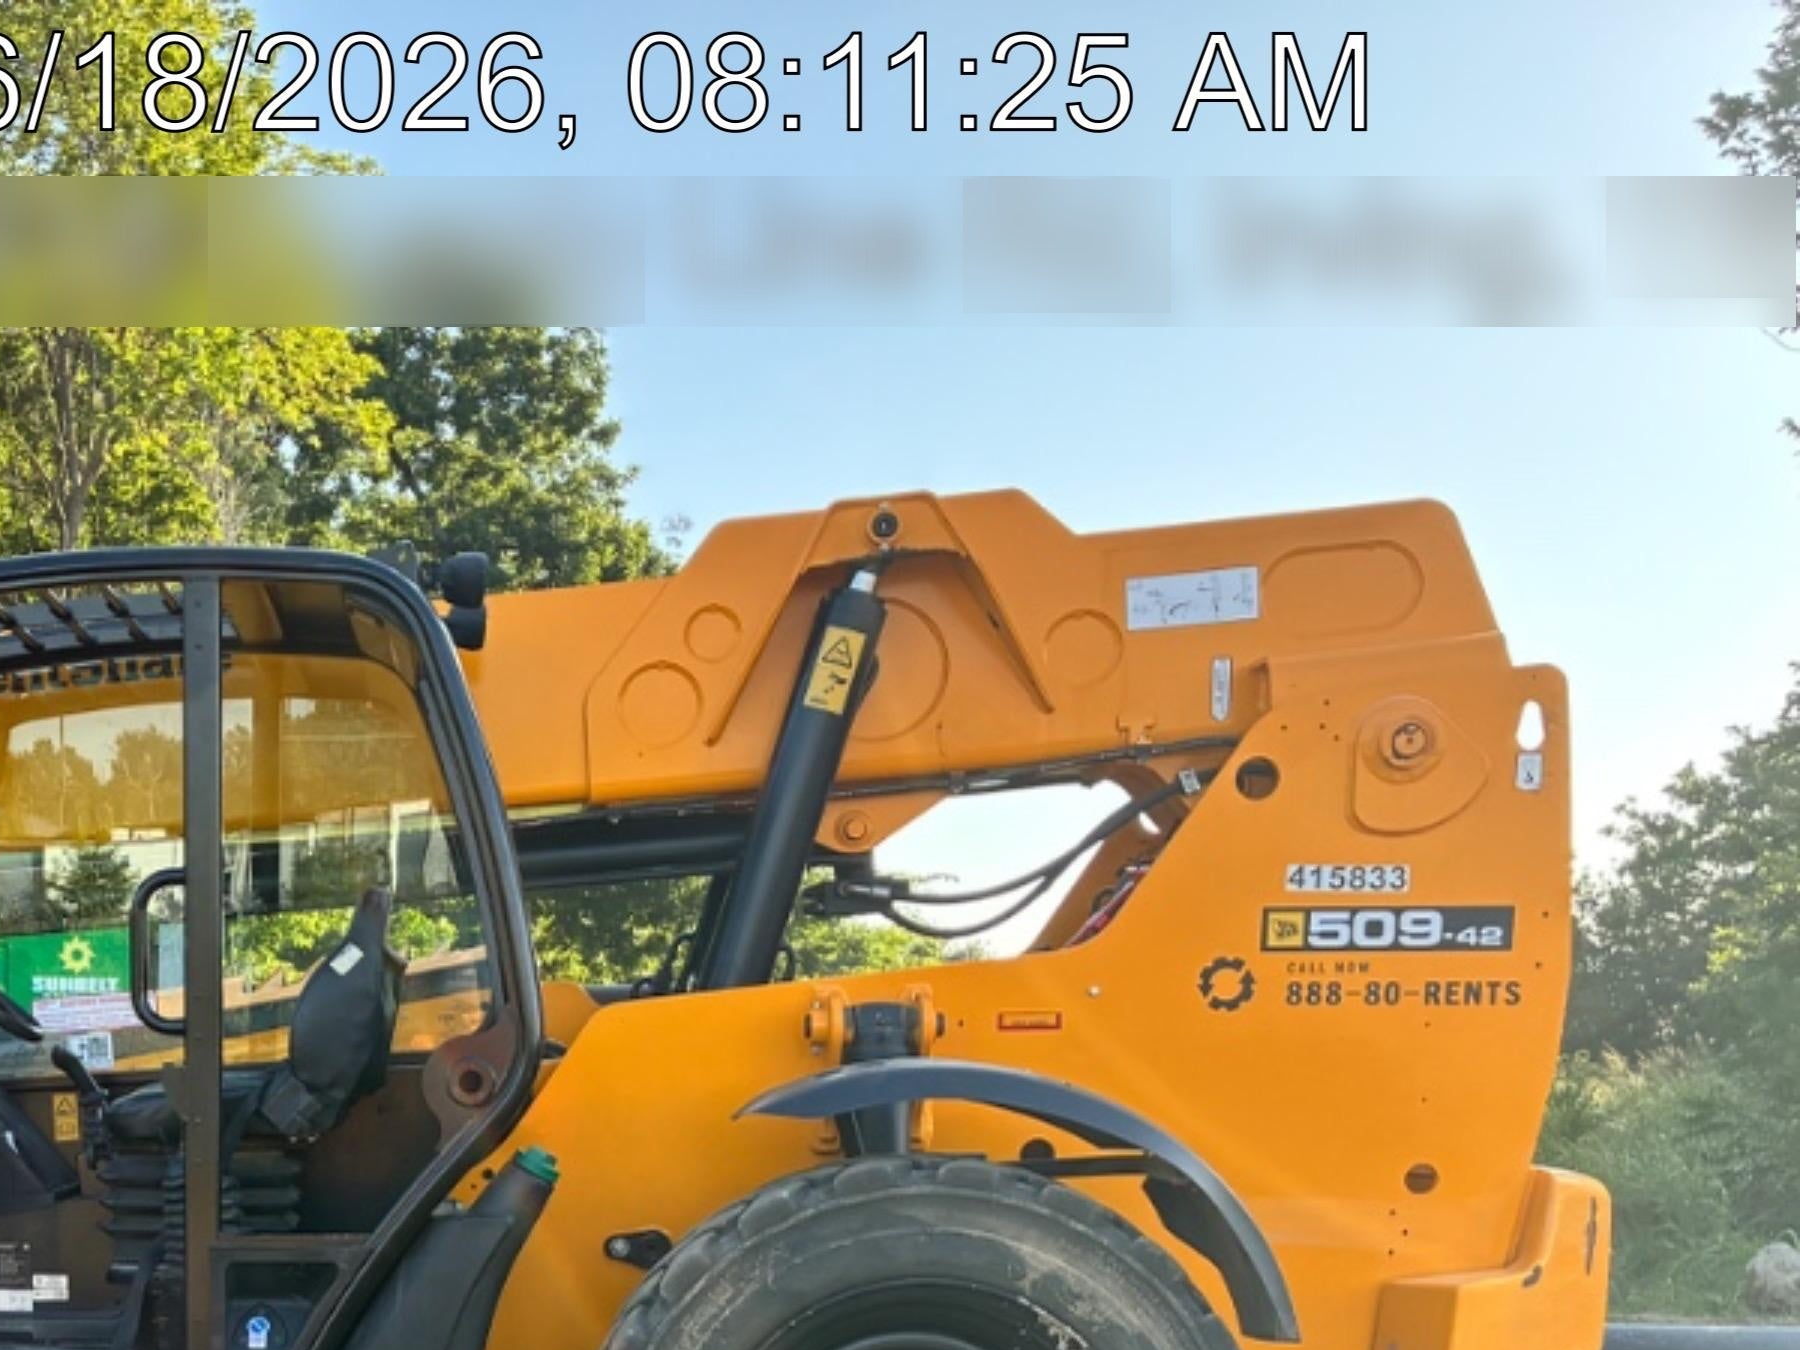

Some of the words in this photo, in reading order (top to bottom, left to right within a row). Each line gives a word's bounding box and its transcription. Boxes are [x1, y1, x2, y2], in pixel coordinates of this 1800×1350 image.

[1287, 865, 1408, 891] 415833
[1286, 961, 1326, 974] CALL
[1335, 961, 1369, 974] NOW
[1286, 980, 1522, 1006] 888-80-RENTS
